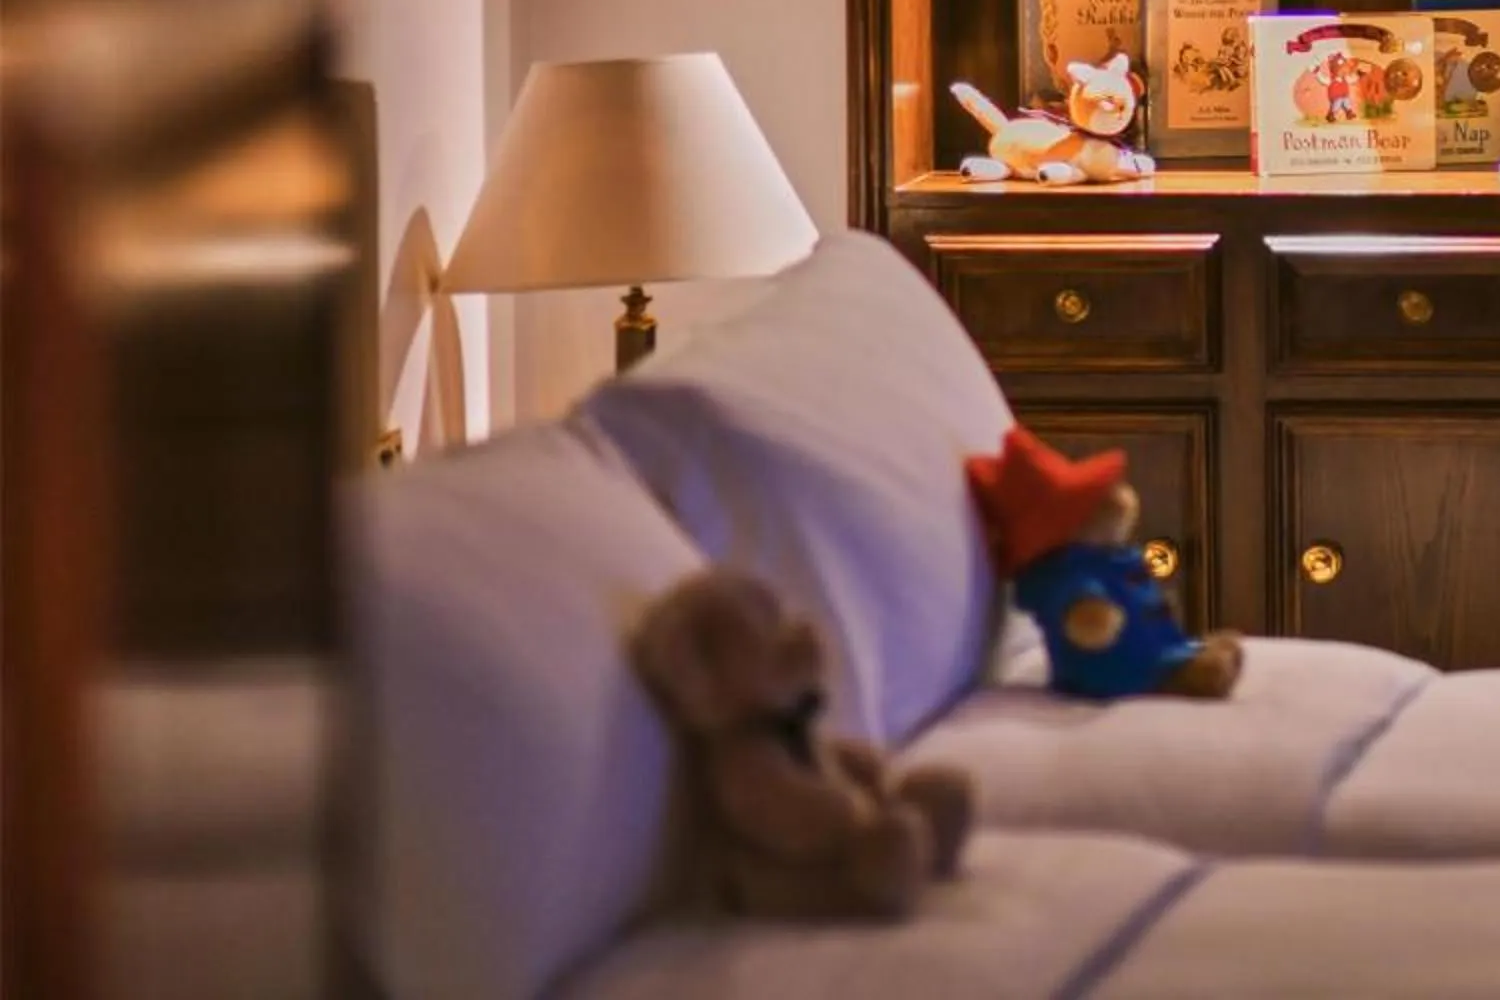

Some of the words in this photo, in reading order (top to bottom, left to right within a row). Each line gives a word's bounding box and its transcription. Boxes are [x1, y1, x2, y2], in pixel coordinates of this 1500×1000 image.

[1283, 130, 1359, 151] Postman
[1367, 129, 1410, 150] Bear
[1454, 121, 1491, 149] Nap
